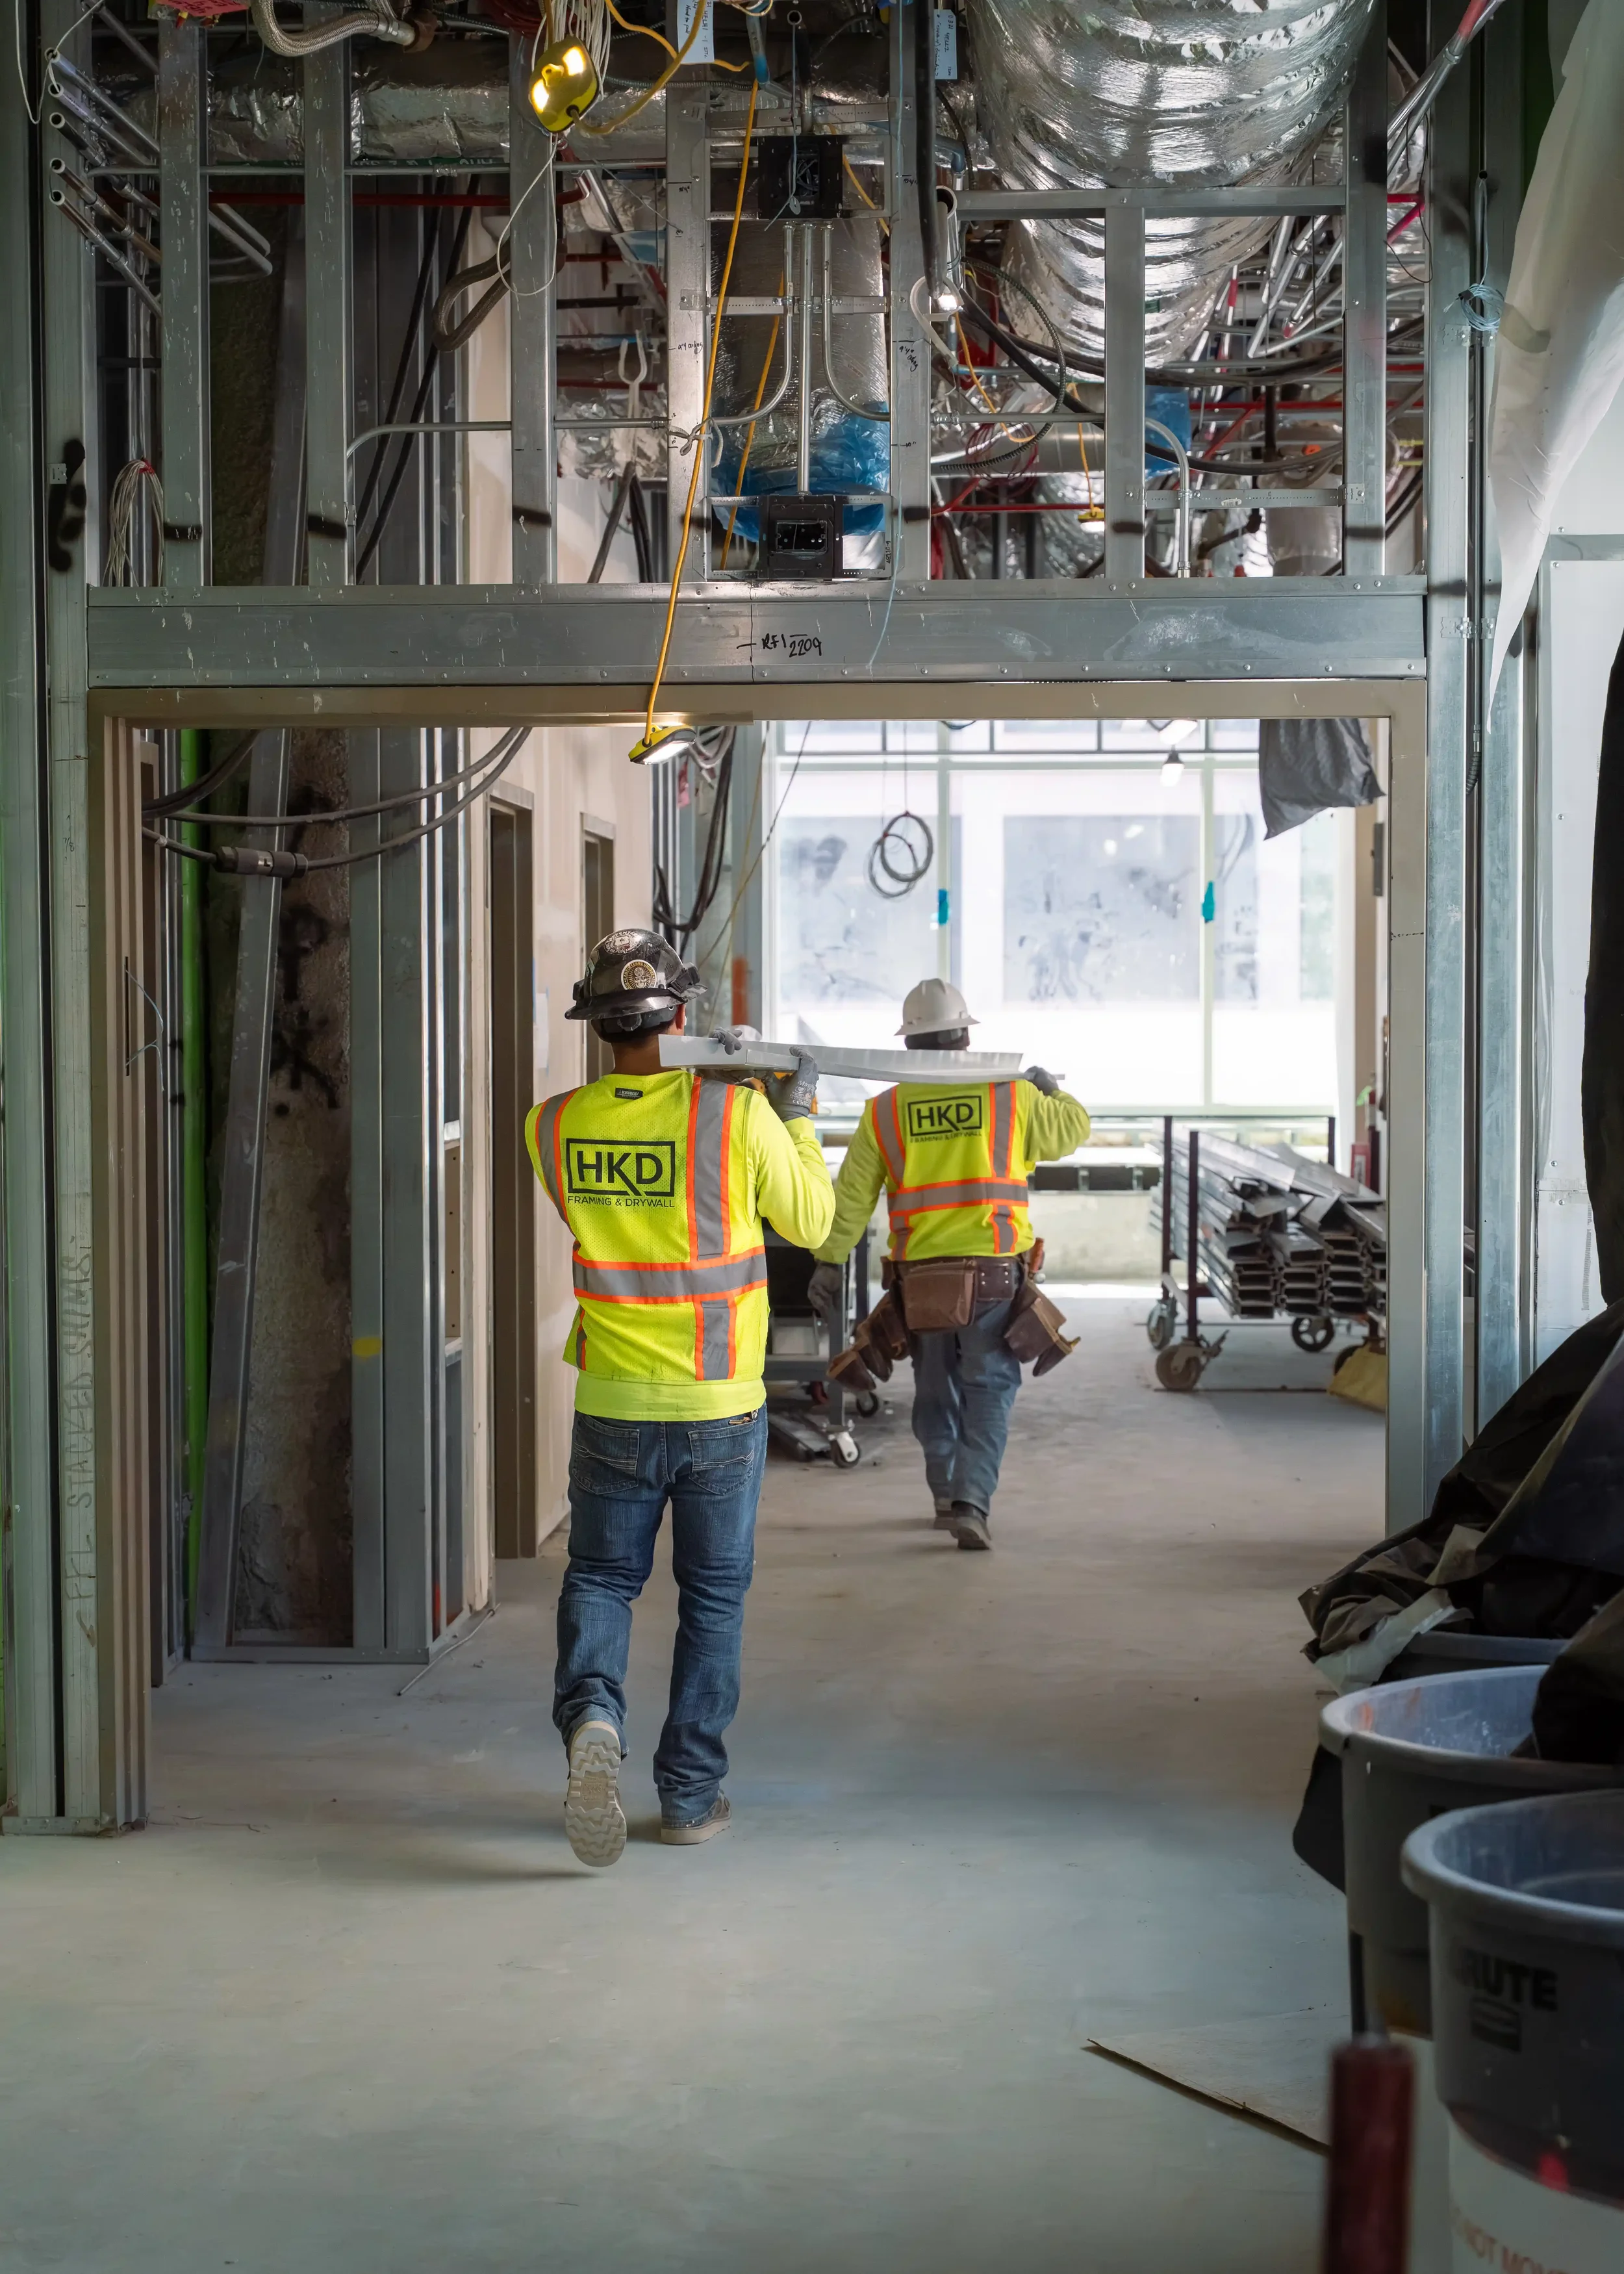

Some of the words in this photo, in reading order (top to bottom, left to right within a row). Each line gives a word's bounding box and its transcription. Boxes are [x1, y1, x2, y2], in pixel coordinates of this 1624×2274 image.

[789, 636, 822, 658] 2209
[917, 1103, 974, 1131] HKD
[577, 1151, 663, 1196] HKD
[567, 1195, 611, 1206] FRAMING
[615, 1198, 622, 1207] &
[626, 1198, 675, 1208] DRYWALL
[63, 1373, 94, 1508] STACKED
